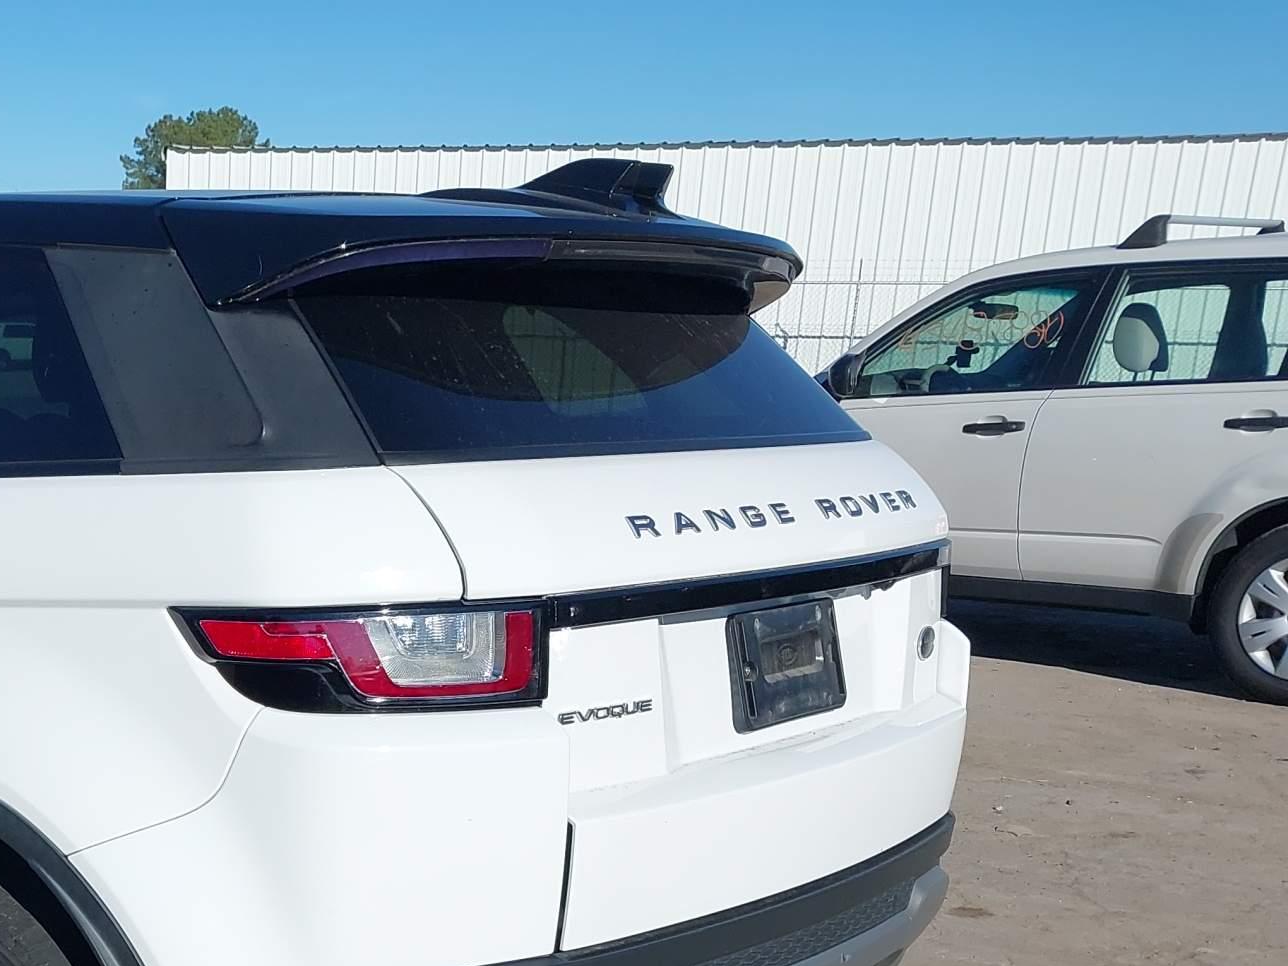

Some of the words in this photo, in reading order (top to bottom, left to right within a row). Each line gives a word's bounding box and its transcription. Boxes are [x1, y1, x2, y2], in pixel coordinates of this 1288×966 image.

[625, 502, 796, 539] RANGE
[814, 489, 918, 520] ROVER
[557, 699, 653, 725] EVOQUE
